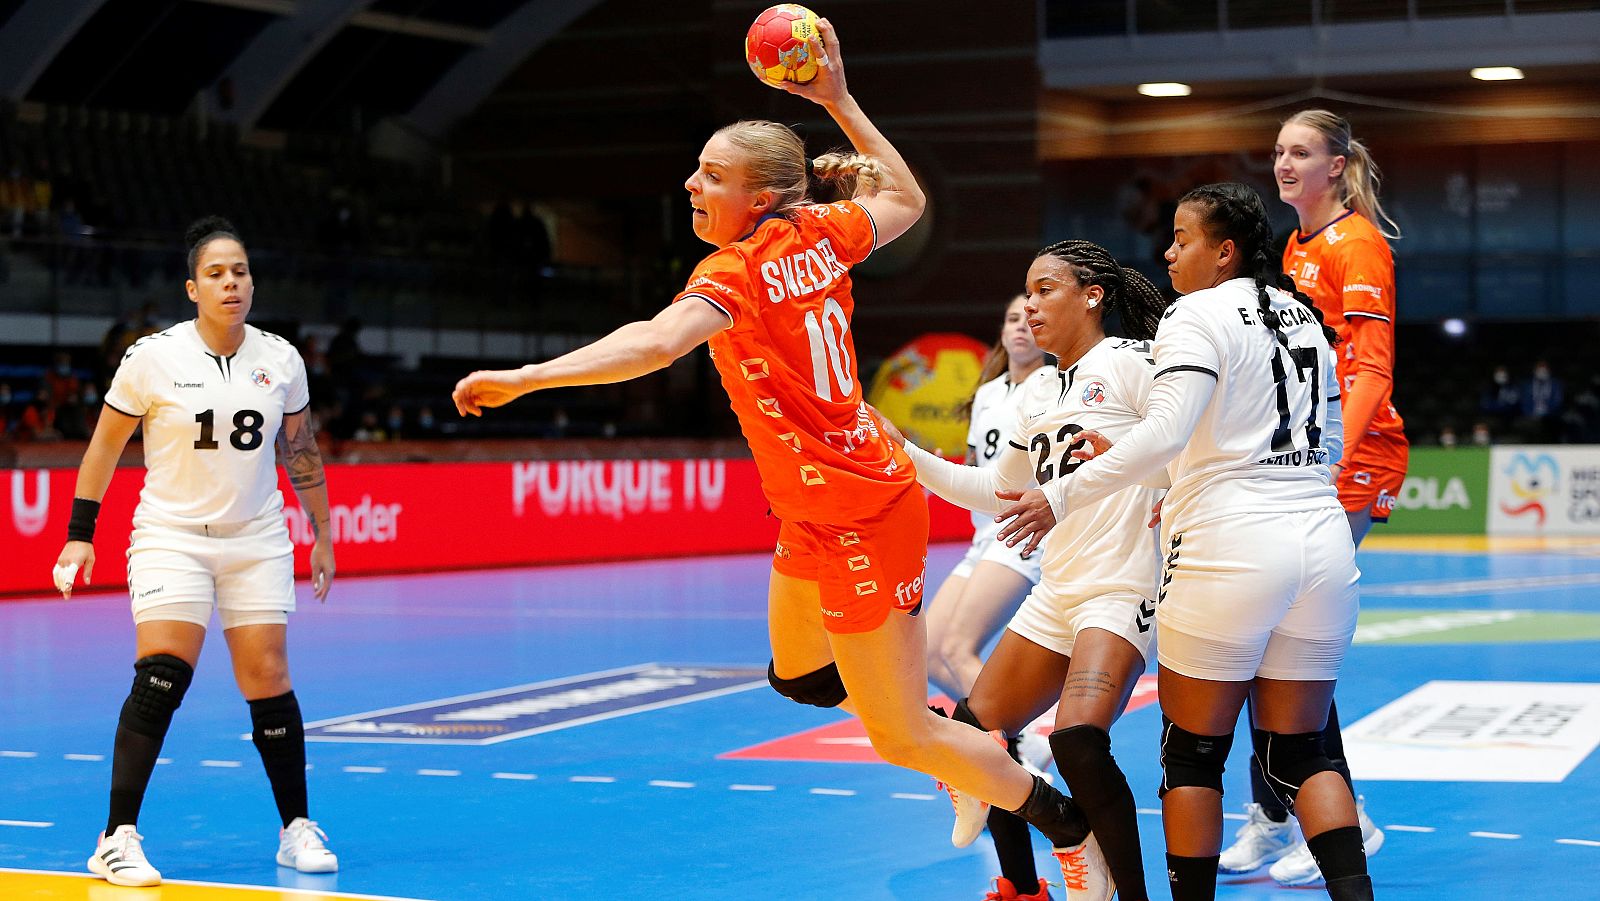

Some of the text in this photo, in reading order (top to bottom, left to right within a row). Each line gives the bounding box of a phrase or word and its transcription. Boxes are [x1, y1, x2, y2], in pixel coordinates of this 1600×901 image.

[805, 297, 853, 402] 10
[174, 381, 205, 389] hummel
[1270, 346, 1321, 453] 17
[193, 409, 265, 451] 18
[984, 428, 1000, 460] 8
[1031, 423, 1086, 486] 22
[1393, 477, 1471, 511] OLA
